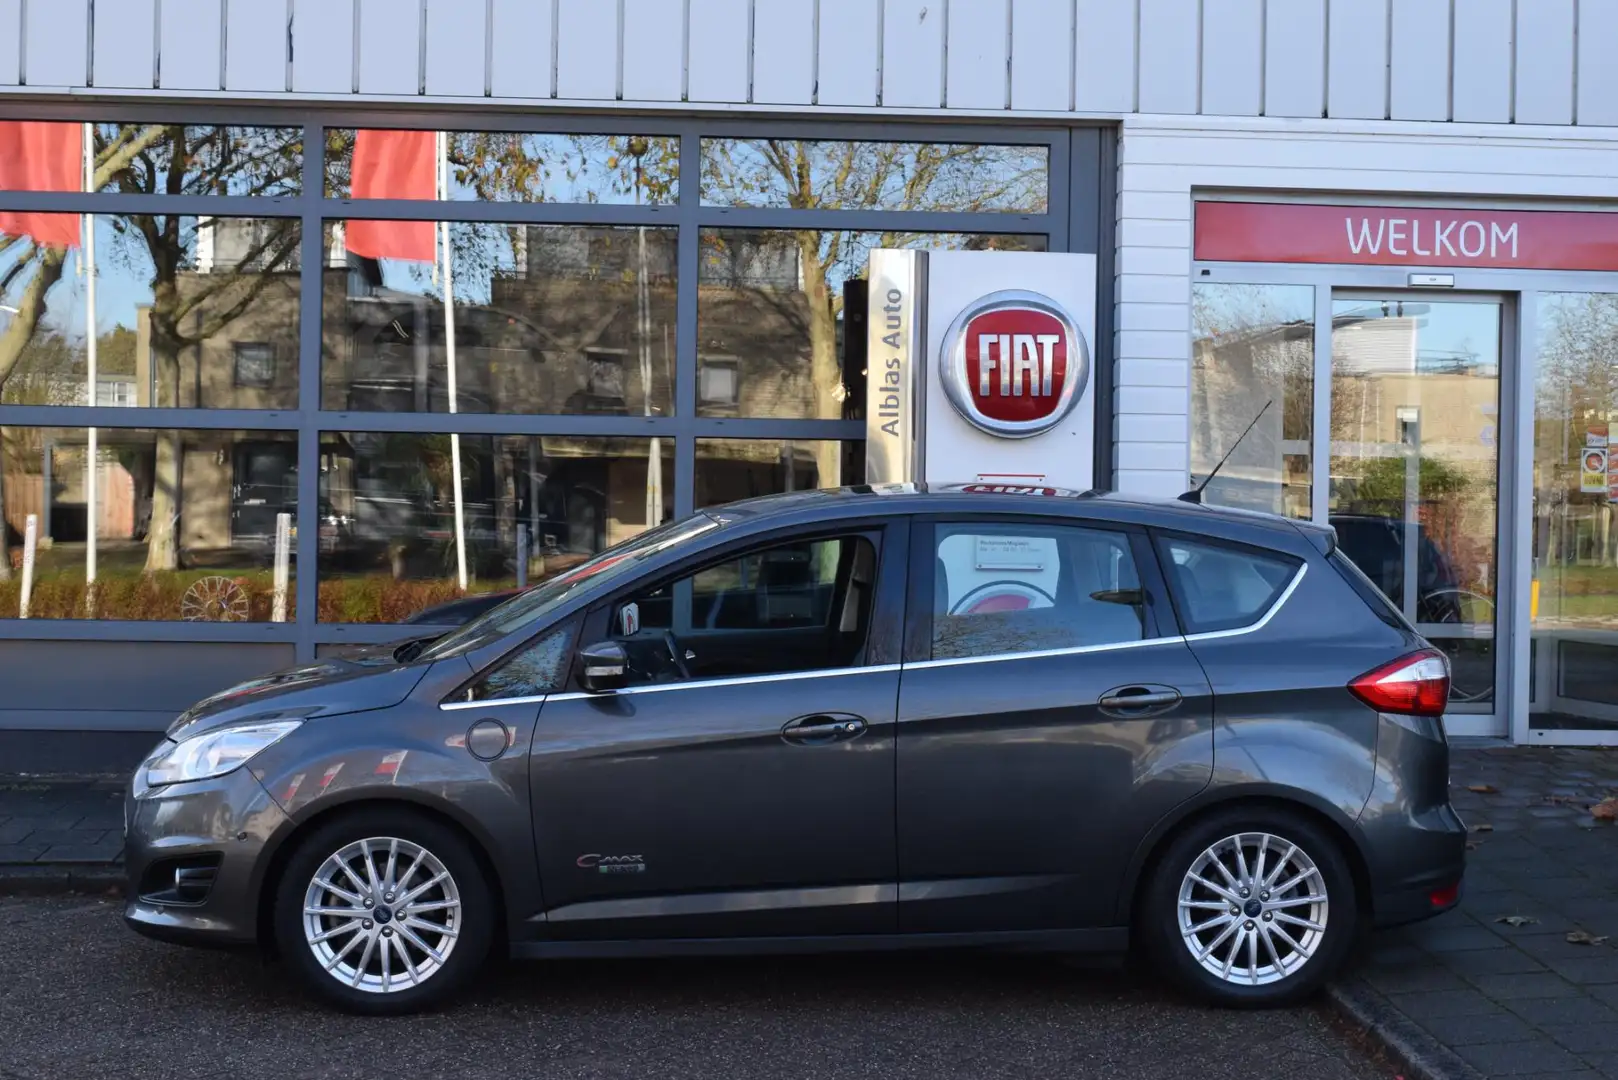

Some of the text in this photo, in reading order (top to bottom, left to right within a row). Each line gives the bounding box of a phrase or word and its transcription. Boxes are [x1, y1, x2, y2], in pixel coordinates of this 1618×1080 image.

[1345, 217, 1519, 258] WELKOM
[878, 288, 903, 438] Alblas Auto
[978, 333, 1060, 397] FIAT
